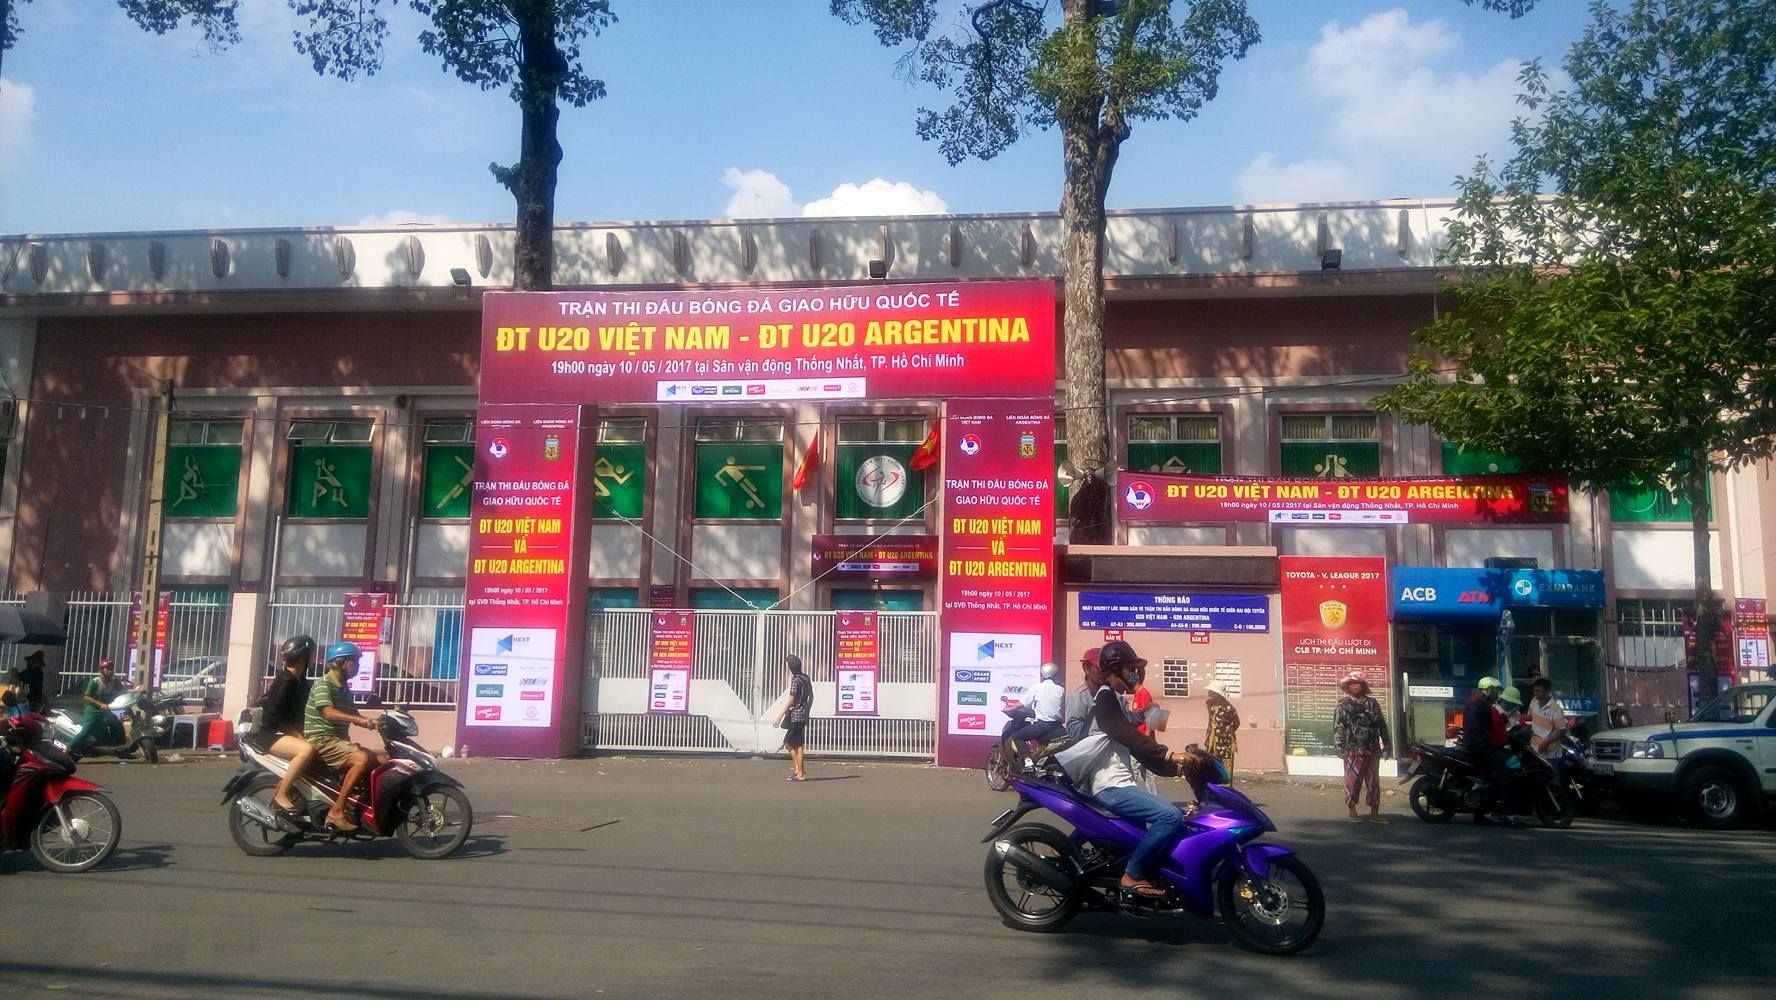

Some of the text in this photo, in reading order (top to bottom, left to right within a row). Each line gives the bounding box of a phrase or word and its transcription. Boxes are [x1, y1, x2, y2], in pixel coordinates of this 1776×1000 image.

[559, 290, 960, 318] TRẬN THI ĐẤU BÓNG ĐÁ GIAO HỮU QUỐC TẾ
[496, 327, 530, 351] ĐT
[538, 327, 590, 351] U20
[598, 322, 656, 356] VIỆT
[665, 326, 730, 350] NAM
[758, 324, 793, 349] ĐT
[802, 323, 855, 347] U20
[864, 317, 1030, 346] ARGENTINA
[551, 361, 585, 374] 19h00
[588, 361, 616, 377] ngày
[620, 362, 632, 374] 10
[642, 361, 656, 373] 05
[666, 361, 691, 373] 2017
[695, 360, 710, 375] tại
[712, 359, 734, 373] Sân
[737, 359, 759, 374] vận
[762, 358, 791, 374] động
[795, 354, 832, 373] Thống
[836, 355, 867, 372] Nhất,
[870, 356, 888, 369] TP.
[891, 353, 909, 368] Hồ
[911, 353, 932, 367] Chí
[935, 353, 964, 367] Minh
[474, 480, 570, 492] TRẬN THI ĐẤU BÓNG ĐÁ
[946, 478, 1048, 490] TRẬN THI ĐẤU BÓNG ĐÁ
[1167, 485, 1188, 498] ĐT
[1195, 485, 1227, 498] U20
[1234, 482, 1271, 501] VIỆT
[1276, 485, 1319, 499] NAM
[1337, 485, 1361, 499] ĐT
[1366, 485, 1401, 499] U20
[1407, 485, 1515, 499] ARGENTINA
[483, 495, 561, 506] GIAO HỮU QUỐC TẾ
[956, 495, 1041, 506] GIAO HỮU QUỐC TẾ
[1361, 501, 1383, 510] Thống
[480, 516, 561, 537] ĐT U20 VIỆT NAM
[953, 516, 1041, 537] ĐT U20 VIỆT NAM
[514, 536, 527, 554] VÀ
[991, 537, 1005, 555] VÀ
[474, 559, 564, 574] ĐT U20 ARGENTINA
[949, 560, 1047, 577] ĐT U20 ARGENTINA
[1286, 571, 1316, 579] TOYOTA
[1361, 572, 1380, 580] 2017
[1401, 587, 1436, 602] ACB
[1538, 583, 1596, 593] EXIMBANK
[1154, 595, 1191, 604] THÔNG BÁO
[1457, 590, 1491, 603] ATM
[1328, 637, 1343, 645] ĐẤU
[1324, 644, 1337, 654] HỒ
[1338, 646, 1354, 654] CHÍ
